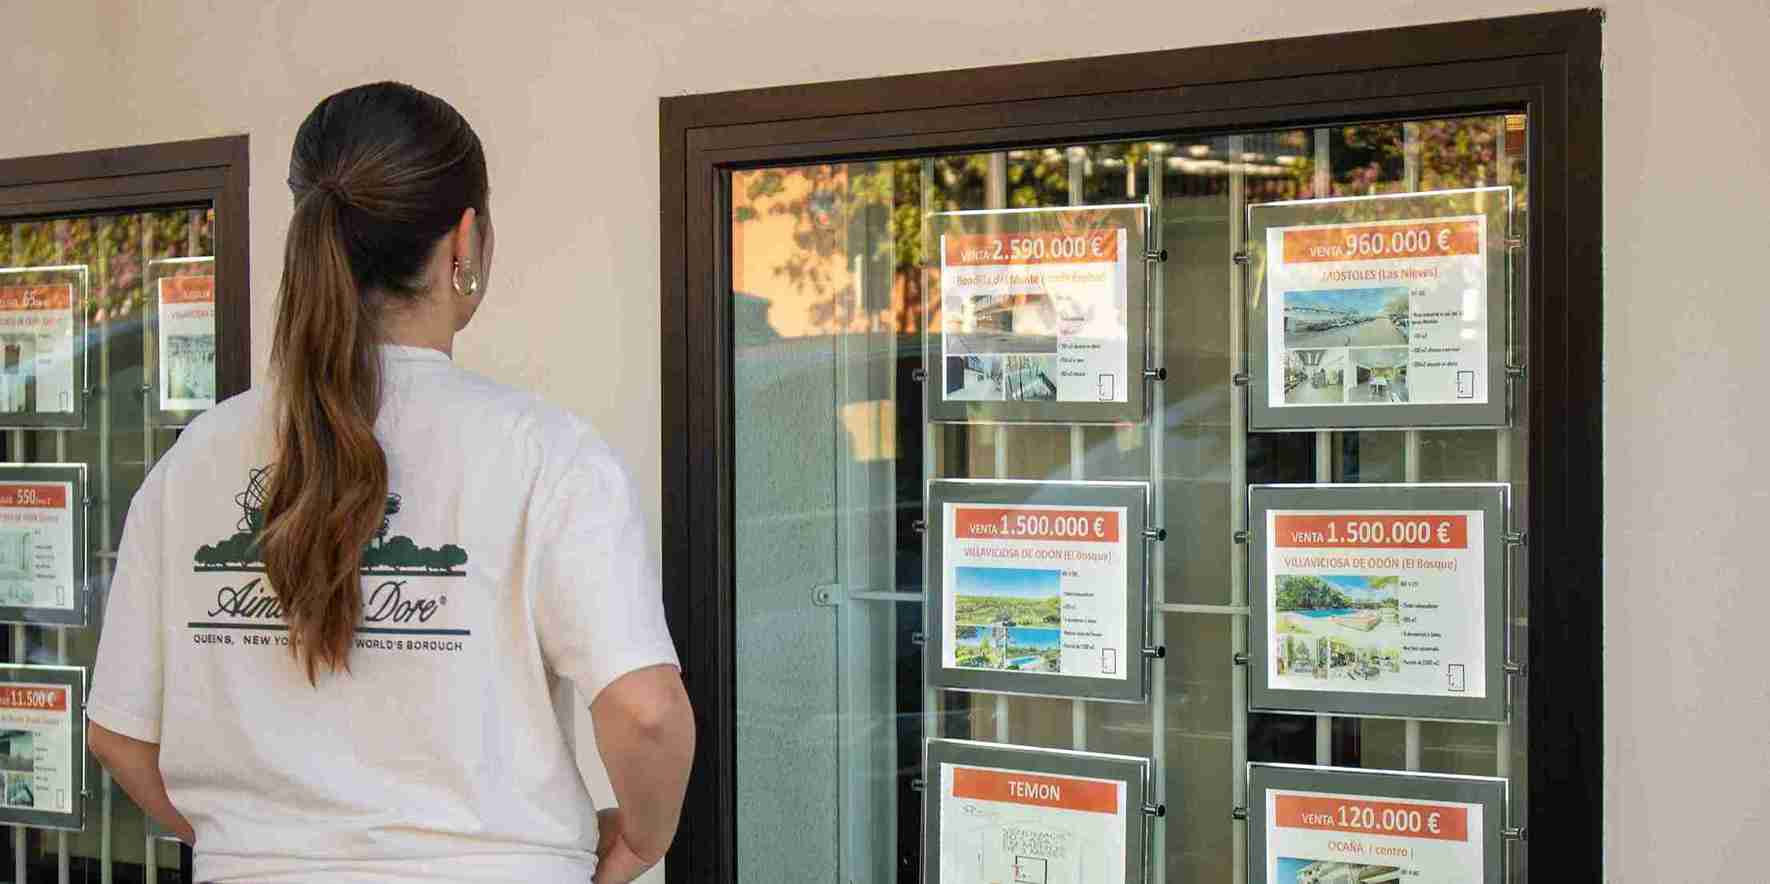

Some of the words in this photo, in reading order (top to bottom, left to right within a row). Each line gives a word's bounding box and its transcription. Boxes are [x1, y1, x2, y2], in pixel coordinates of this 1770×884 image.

[992, 237, 1086, 260] 2.590.000
[1091, 236, 1104, 257] €
[1310, 246, 1343, 257] VENTA
[1345, 230, 1431, 257] 960.000
[1437, 228, 1451, 251] €
[16, 488, 36, 504] 550
[968, 521, 998, 535] VENTA
[1000, 514, 1088, 537] 1.500.000
[1093, 518, 1105, 538] €
[1291, 531, 1324, 544] VENTA
[1327, 521, 1430, 544] 1.500.000
[1436, 521, 1451, 544] €
[1352, 557, 1366, 569] DE
[243, 635, 269, 646] NEW
[355, 639, 403, 651] WORLD'S
[406, 640, 463, 651] BOROUGH
[11, 688, 45, 707] 11.500
[1008, 780, 1061, 801] TEMON
[1301, 812, 1334, 826] VENTA
[1337, 804, 1421, 833] 120.000
[1427, 812, 1440, 834] €
